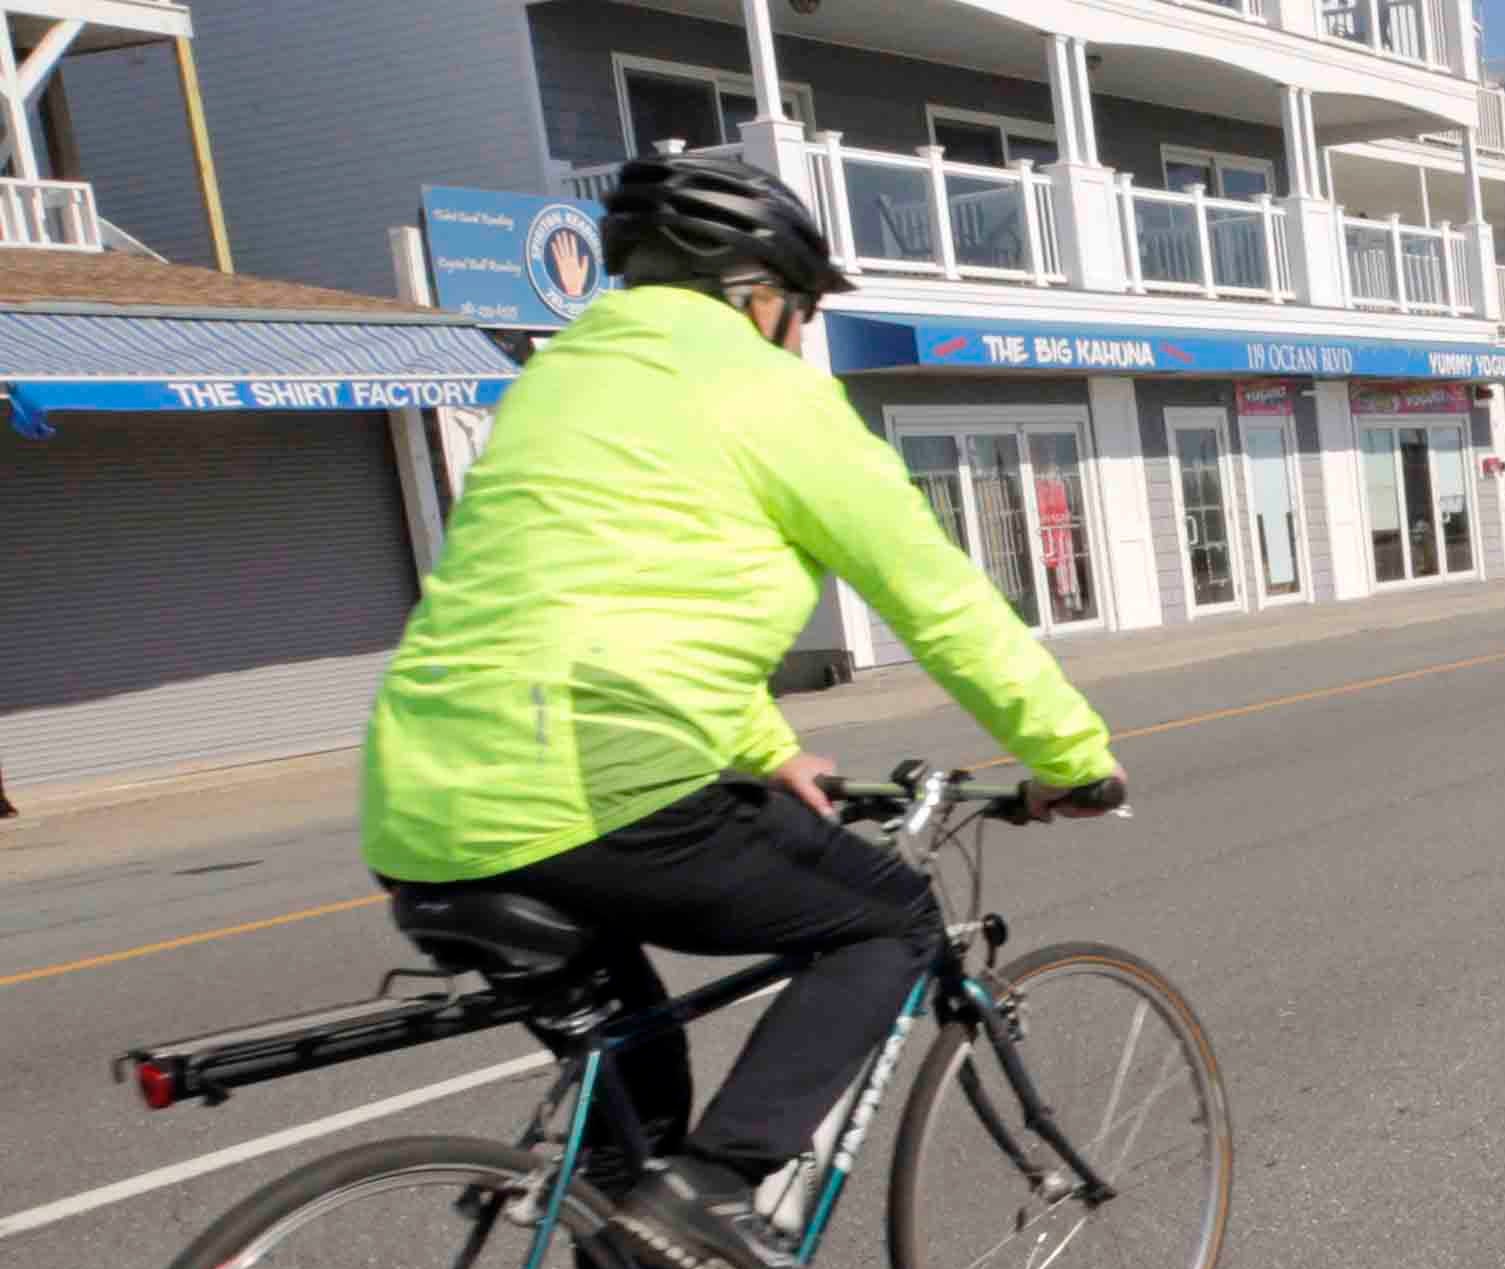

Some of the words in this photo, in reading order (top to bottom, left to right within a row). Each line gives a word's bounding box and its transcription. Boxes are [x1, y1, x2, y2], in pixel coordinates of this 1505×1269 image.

[982, 335, 1028, 363] THE
[1034, 337, 1073, 364] BIG
[1075, 339, 1156, 367] KAHUNA
[1247, 343, 1265, 369] 119
[1268, 344, 1316, 372] OCEAN
[1321, 345, 1353, 373] BLVD
[1428, 352, 1472, 374] YUMMY
[169, 383, 241, 407] THE
[250, 383, 341, 407] SHIRT
[352, 382, 480, 406] FACTORY
